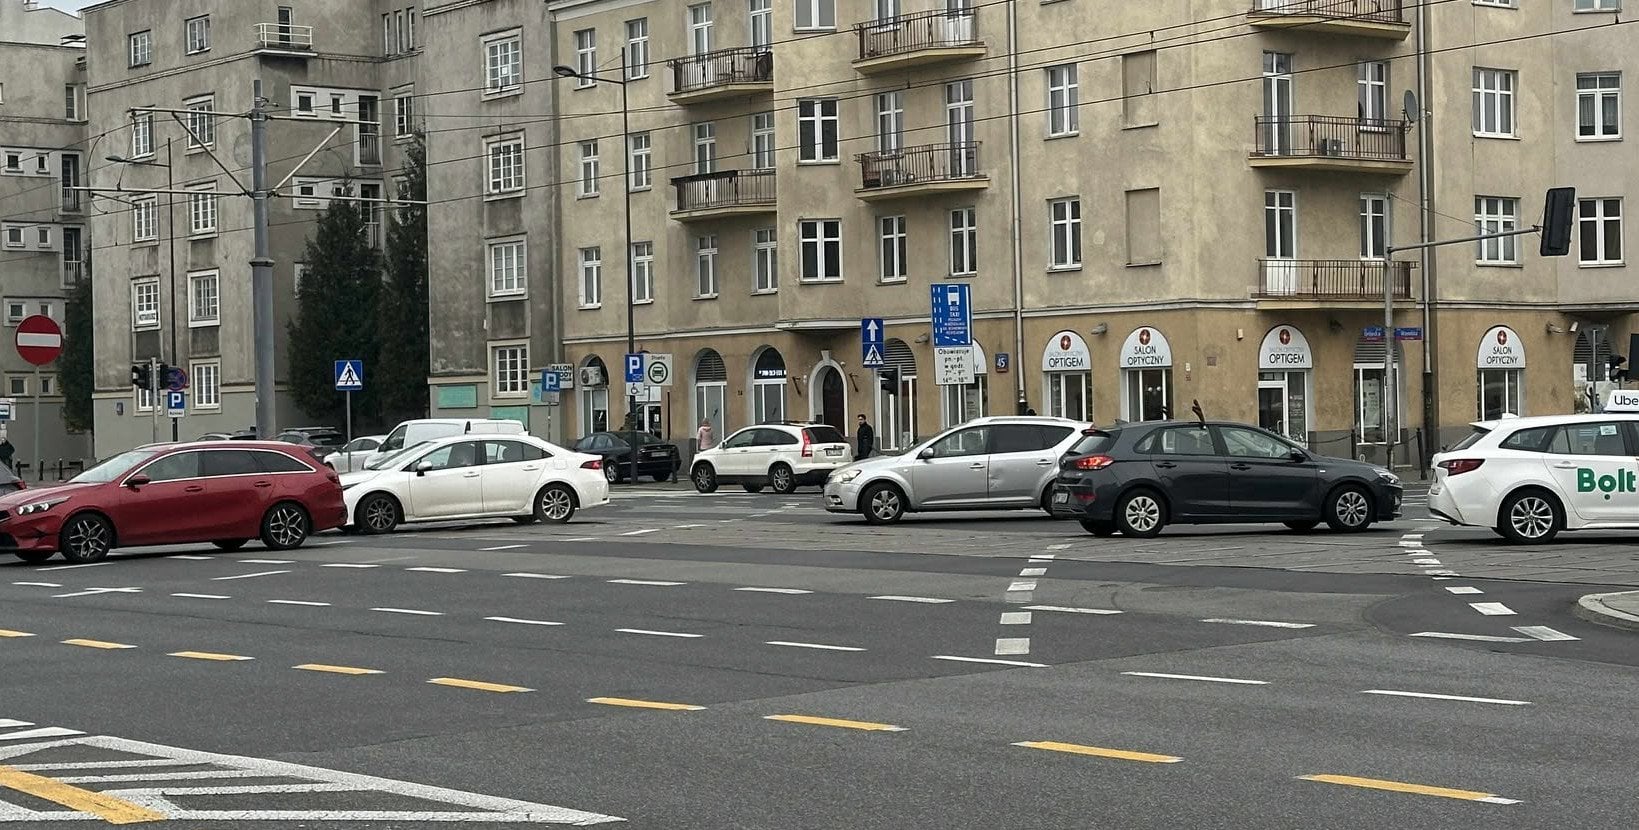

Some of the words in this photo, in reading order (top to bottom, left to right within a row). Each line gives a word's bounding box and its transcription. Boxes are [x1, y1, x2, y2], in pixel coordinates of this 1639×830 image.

[1134, 346, 1156, 355] SALON
[1493, 346, 1512, 355] SALON
[997, 358, 1006, 368] 45
[1048, 358, 1084, 368] OPTIGEM
[1127, 356, 1164, 366] OPTYCZNY
[1269, 353, 1305, 364] OPTIGEM
[1486, 356, 1518, 364] OPTYCZNY
[629, 356, 639, 374] P
[546, 373, 556, 390] P
[171, 393, 181, 407] P
[1577, 468, 1636, 499] Bolt
